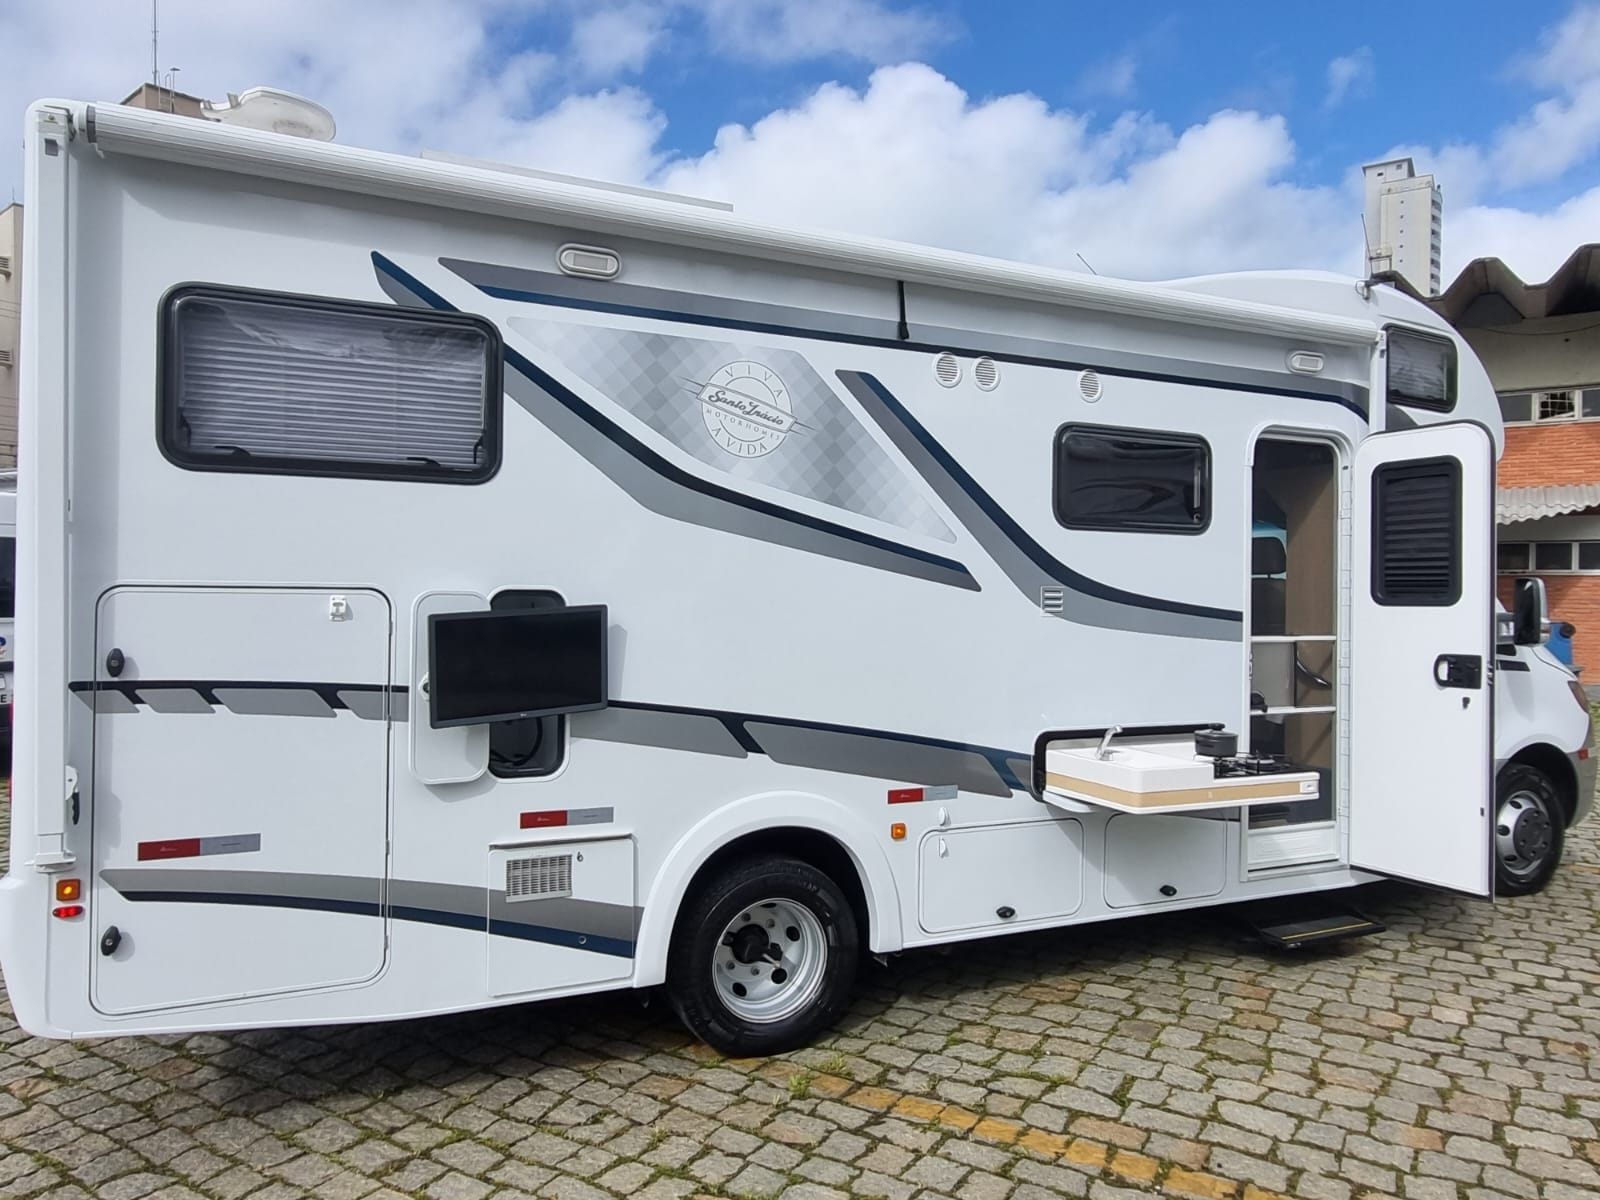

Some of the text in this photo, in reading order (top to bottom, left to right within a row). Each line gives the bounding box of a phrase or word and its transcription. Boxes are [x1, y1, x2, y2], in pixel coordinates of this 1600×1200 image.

[724, 364, 784, 398] VIVA
[708, 390, 746, 411] Santo
[726, 437, 768, 456] VIDA
